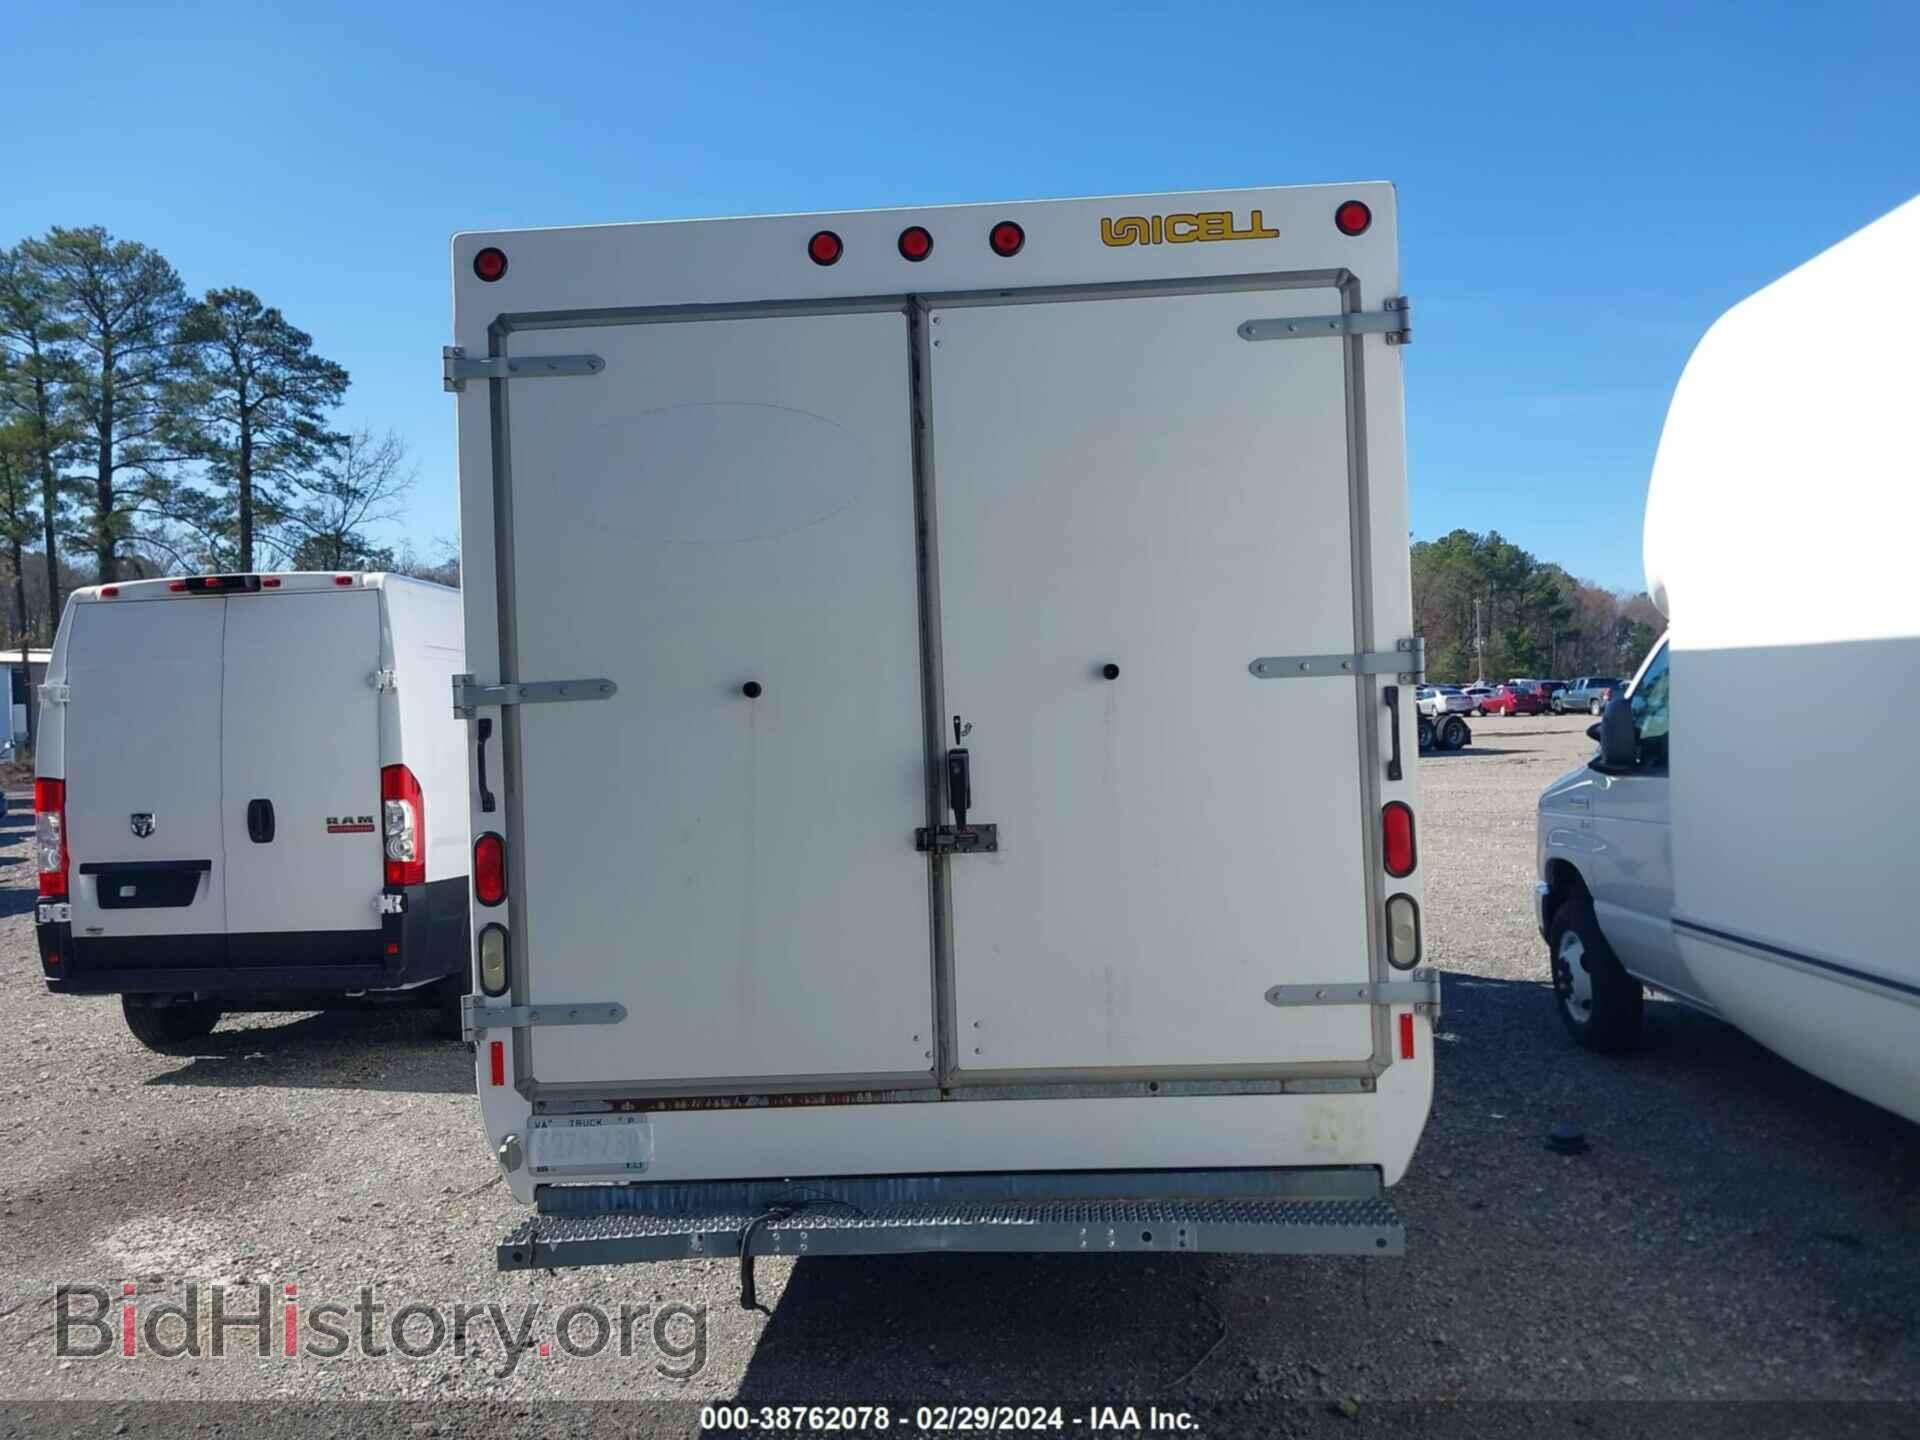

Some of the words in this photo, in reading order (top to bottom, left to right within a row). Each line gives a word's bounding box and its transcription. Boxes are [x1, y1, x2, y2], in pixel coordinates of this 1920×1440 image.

[1100, 210, 1280, 247] UNICELL
[325, 815, 374, 825] RAM
[568, 1118, 604, 1128] TRUCK
